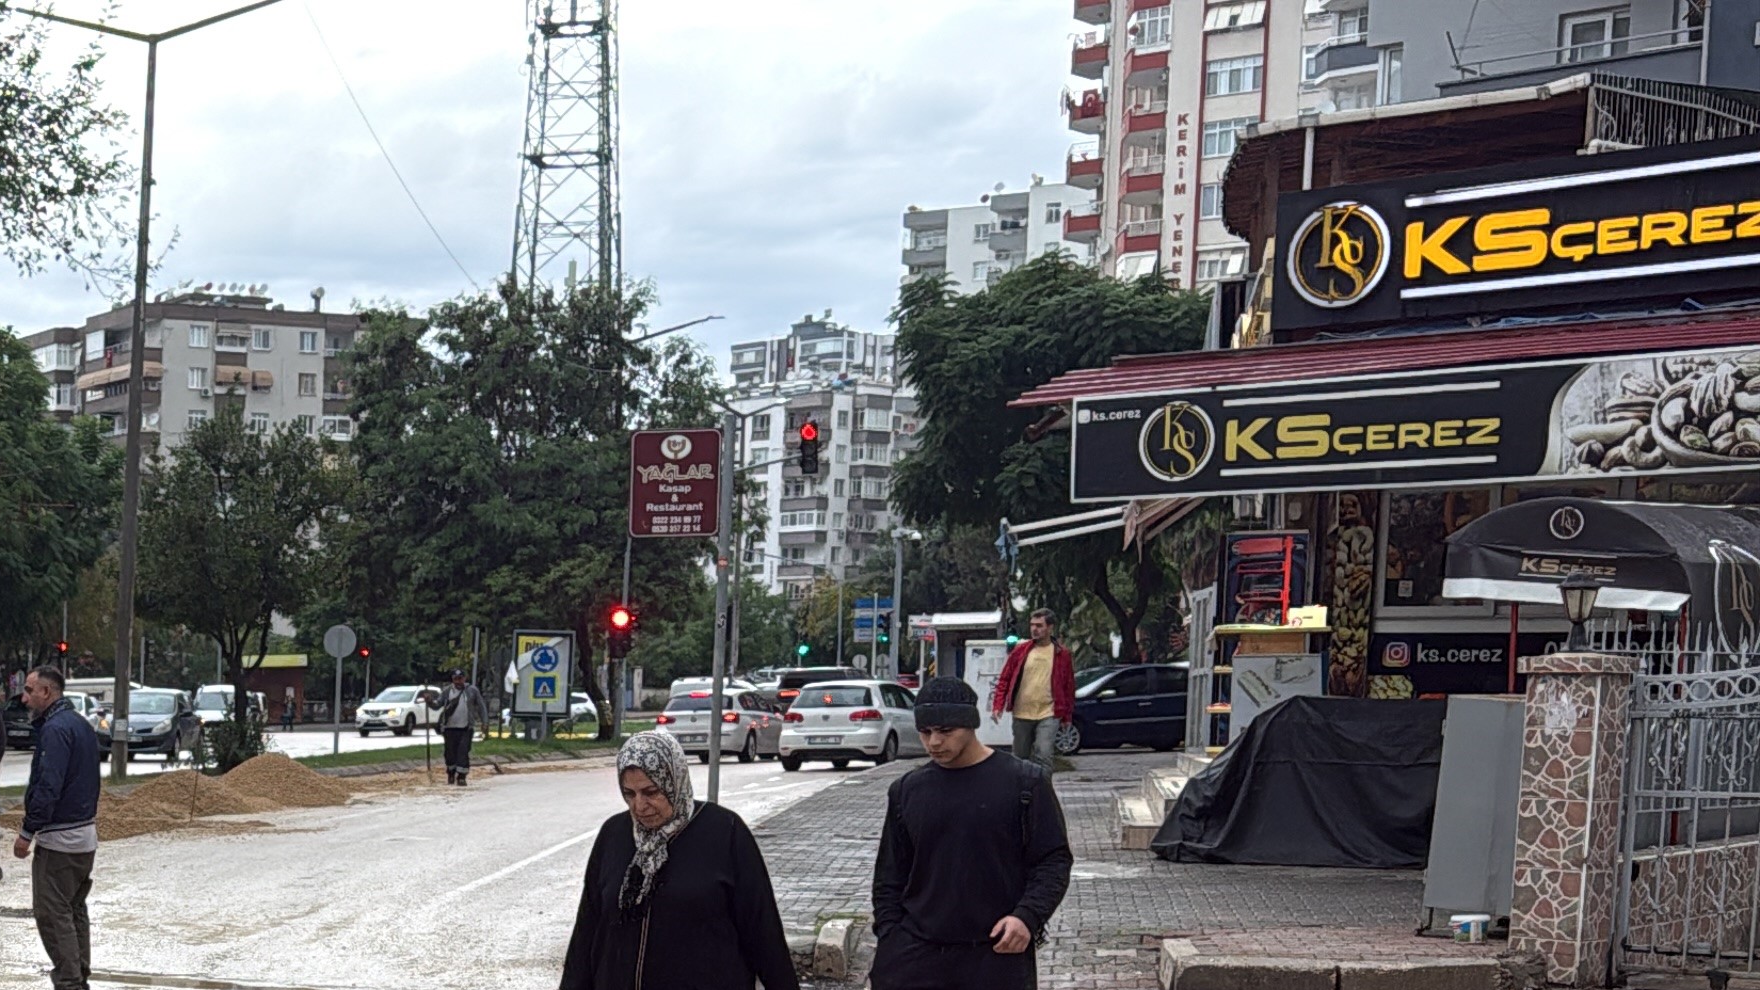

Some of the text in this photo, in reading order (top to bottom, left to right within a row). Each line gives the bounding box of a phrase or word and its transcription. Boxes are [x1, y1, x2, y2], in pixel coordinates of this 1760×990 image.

[1092, 409, 1141, 422] ks.cerez
[637, 463, 715, 484] YAĞLAR
[659, 484, 691, 494] Kasap
[671, 493, 679, 502] &
[646, 502, 703, 512] Restaurant
[1416, 643, 1503, 663] ks.cerez
